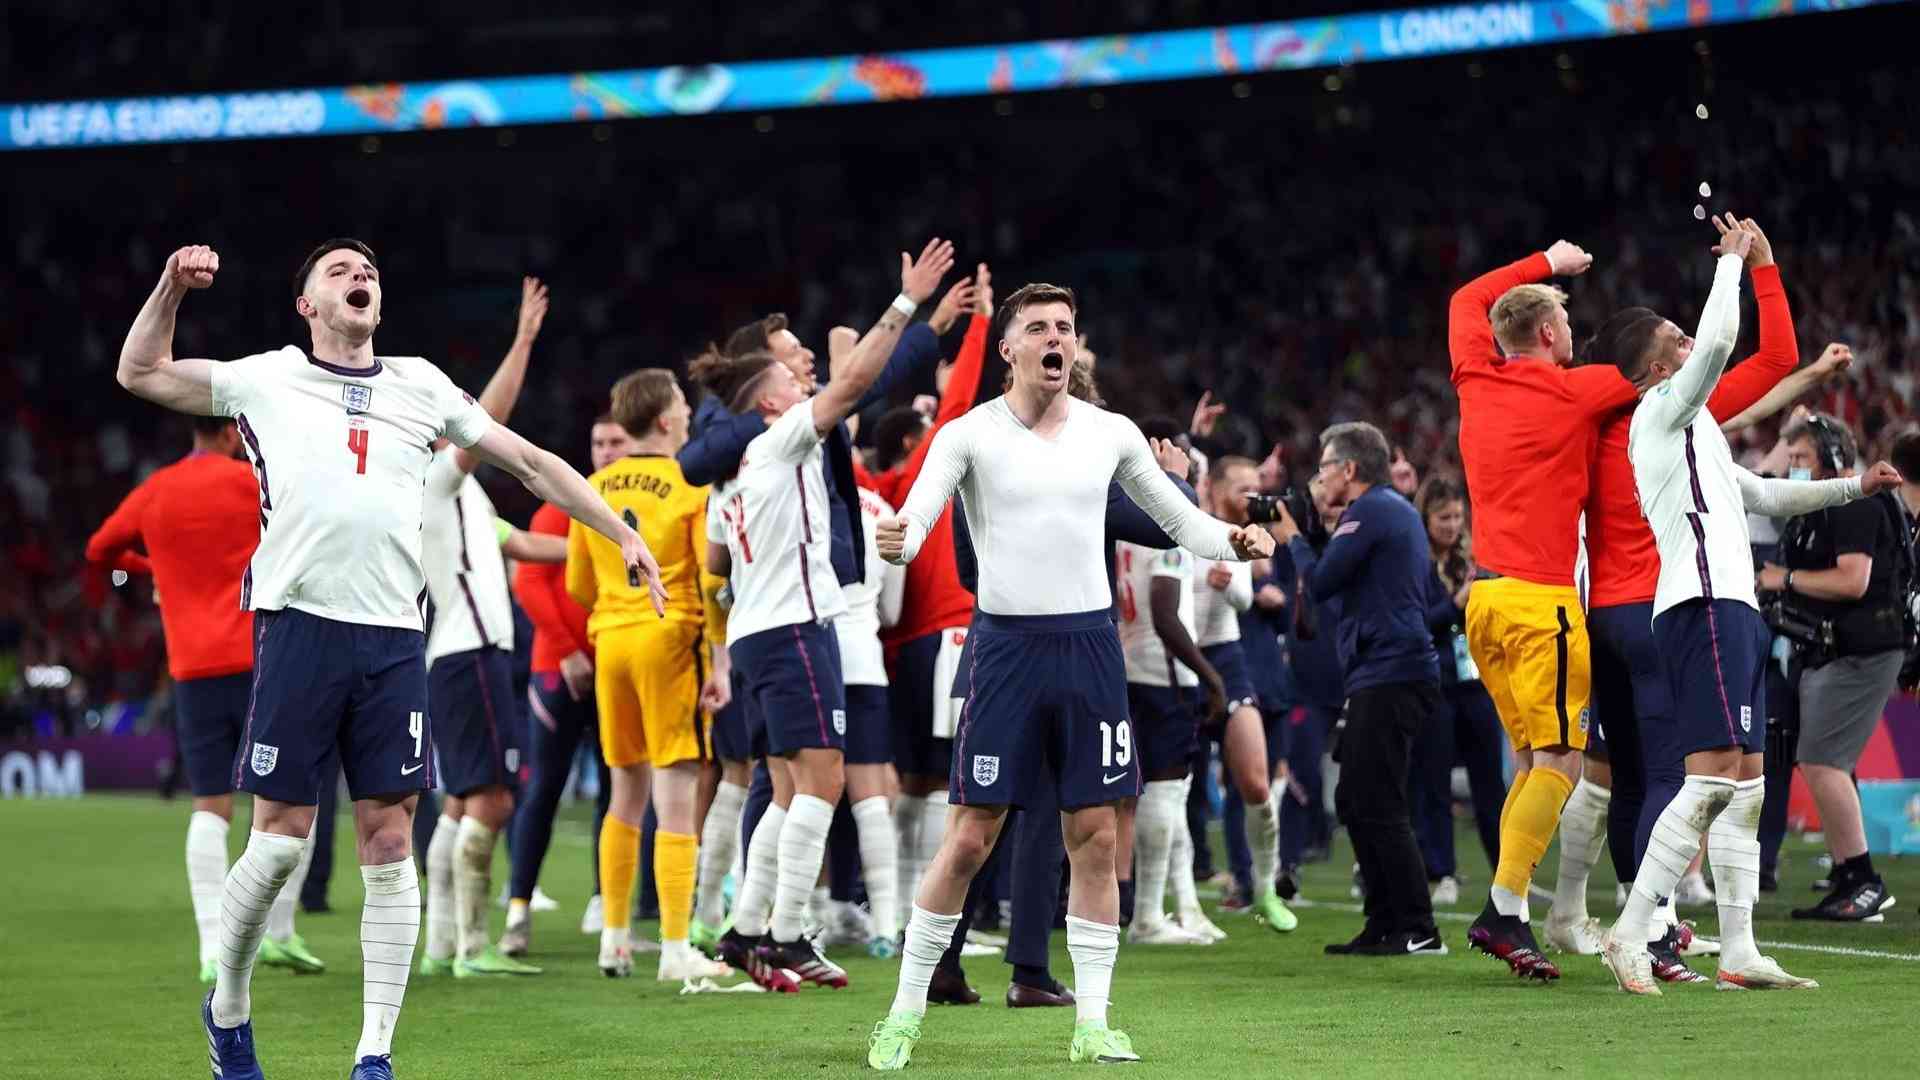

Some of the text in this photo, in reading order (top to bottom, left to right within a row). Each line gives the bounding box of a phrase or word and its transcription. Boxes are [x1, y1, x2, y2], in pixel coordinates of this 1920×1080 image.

[1379, 3, 1535, 56] LONDON
[9, 89, 326, 146] UEFA EURO 2020
[347, 428, 369, 475] 4
[408, 711, 424, 759] 4
[1099, 719, 1132, 767] 19
[0, 749, 84, 795] OM
